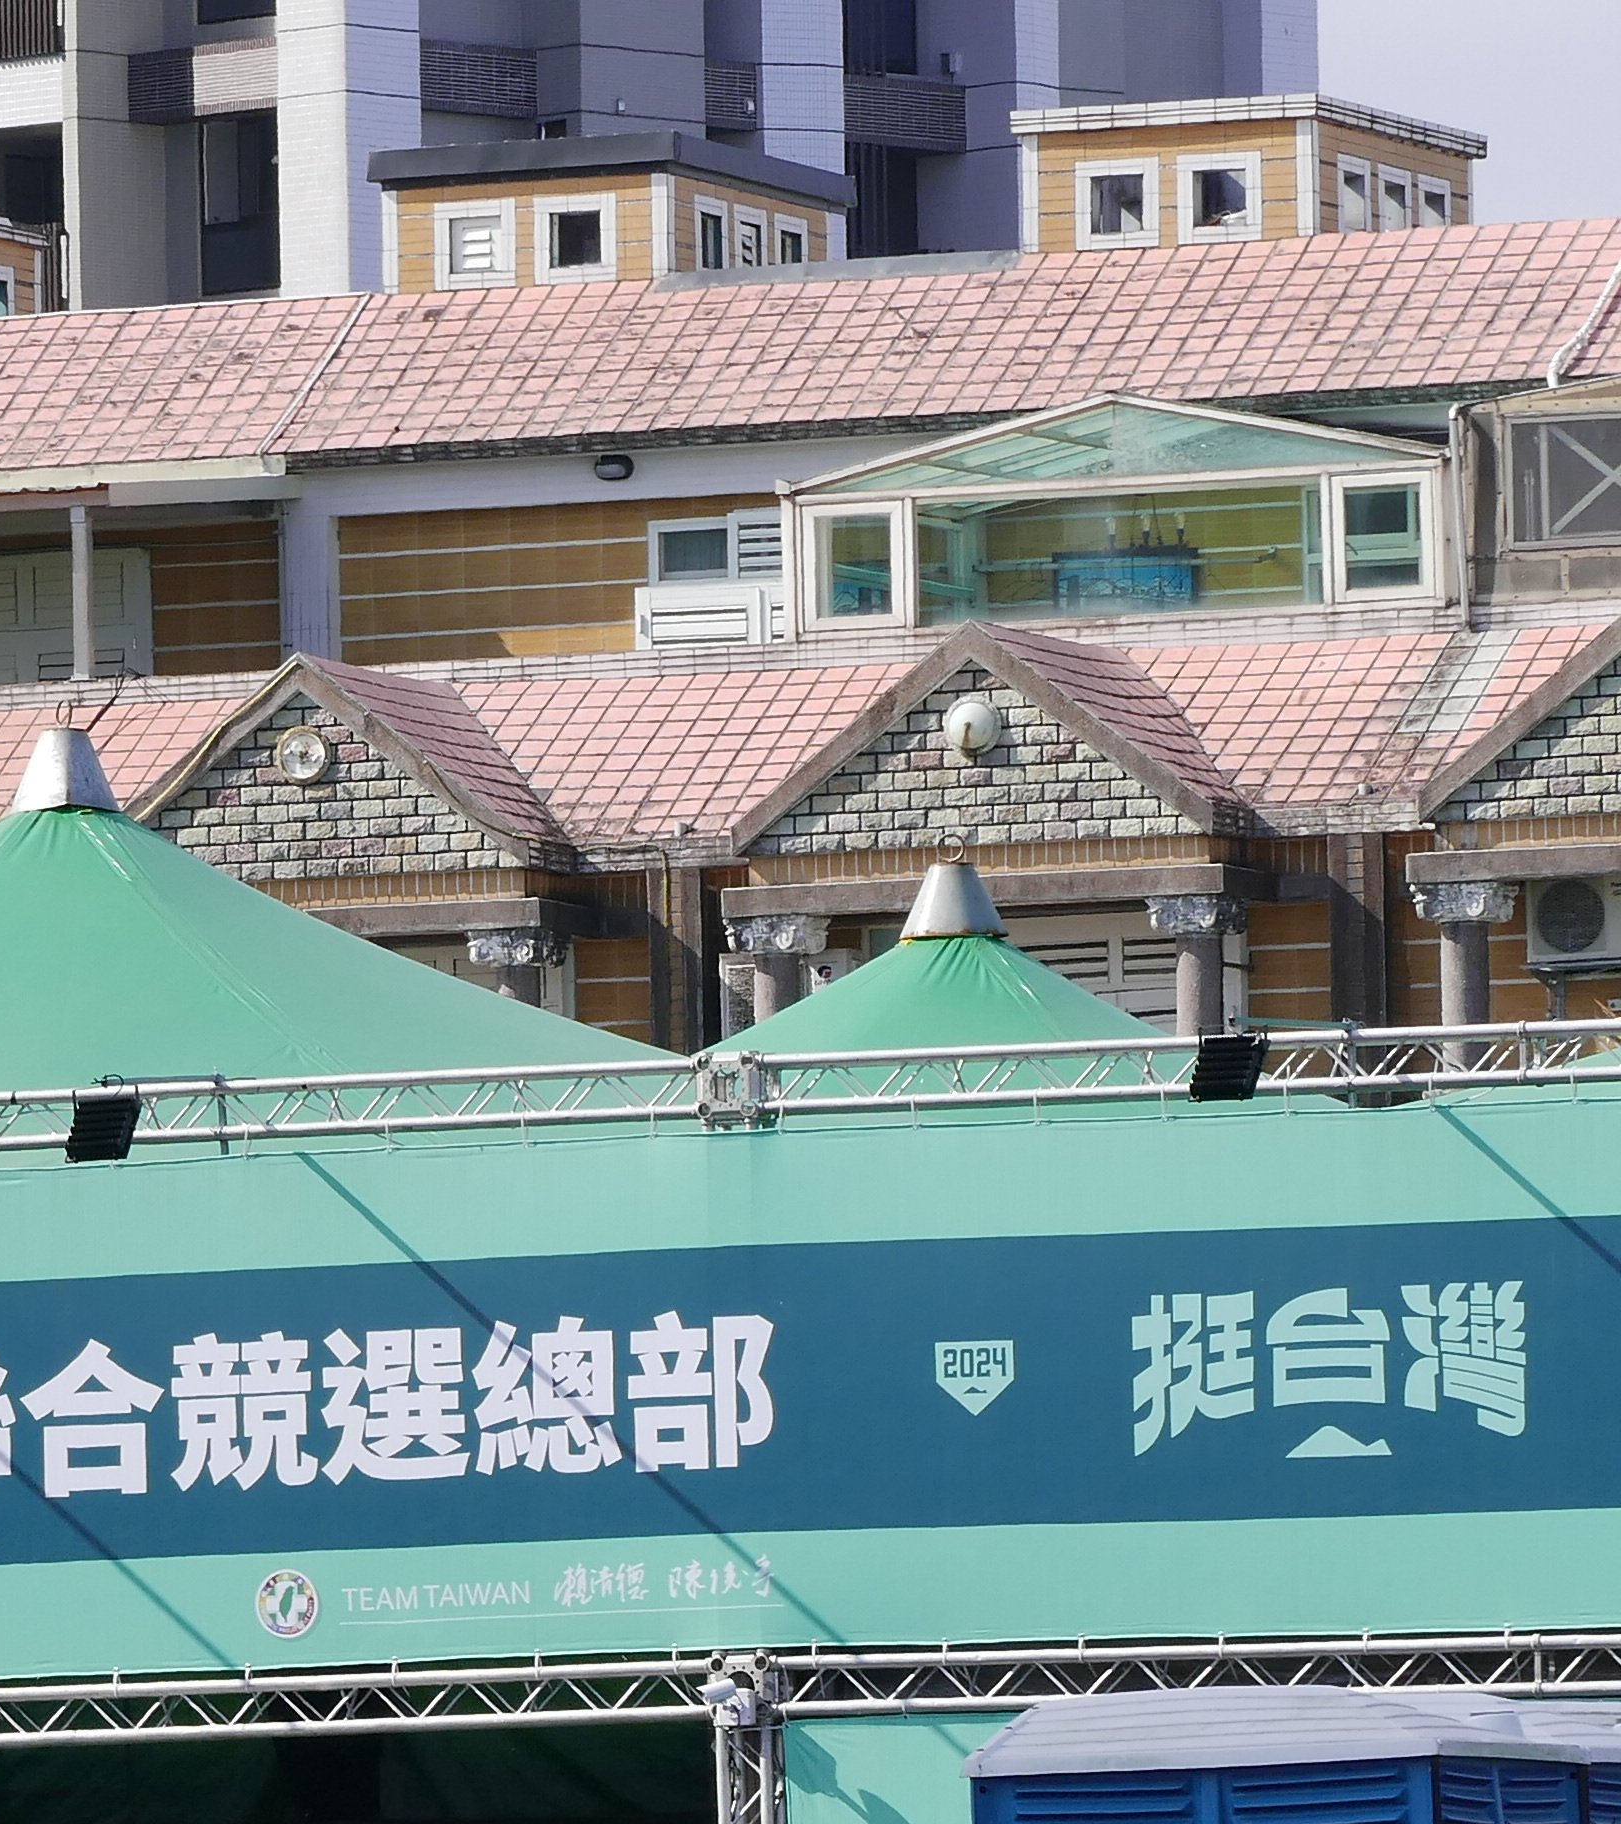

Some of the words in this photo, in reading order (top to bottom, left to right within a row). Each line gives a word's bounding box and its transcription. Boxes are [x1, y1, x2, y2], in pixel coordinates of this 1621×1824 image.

[943, 1346, 1006, 1378] 2024
[1132, 1280, 1526, 1457] 挺台灣
[341, 1586, 418, 1612] TEAM
[423, 1581, 531, 1608] TAIWAN
